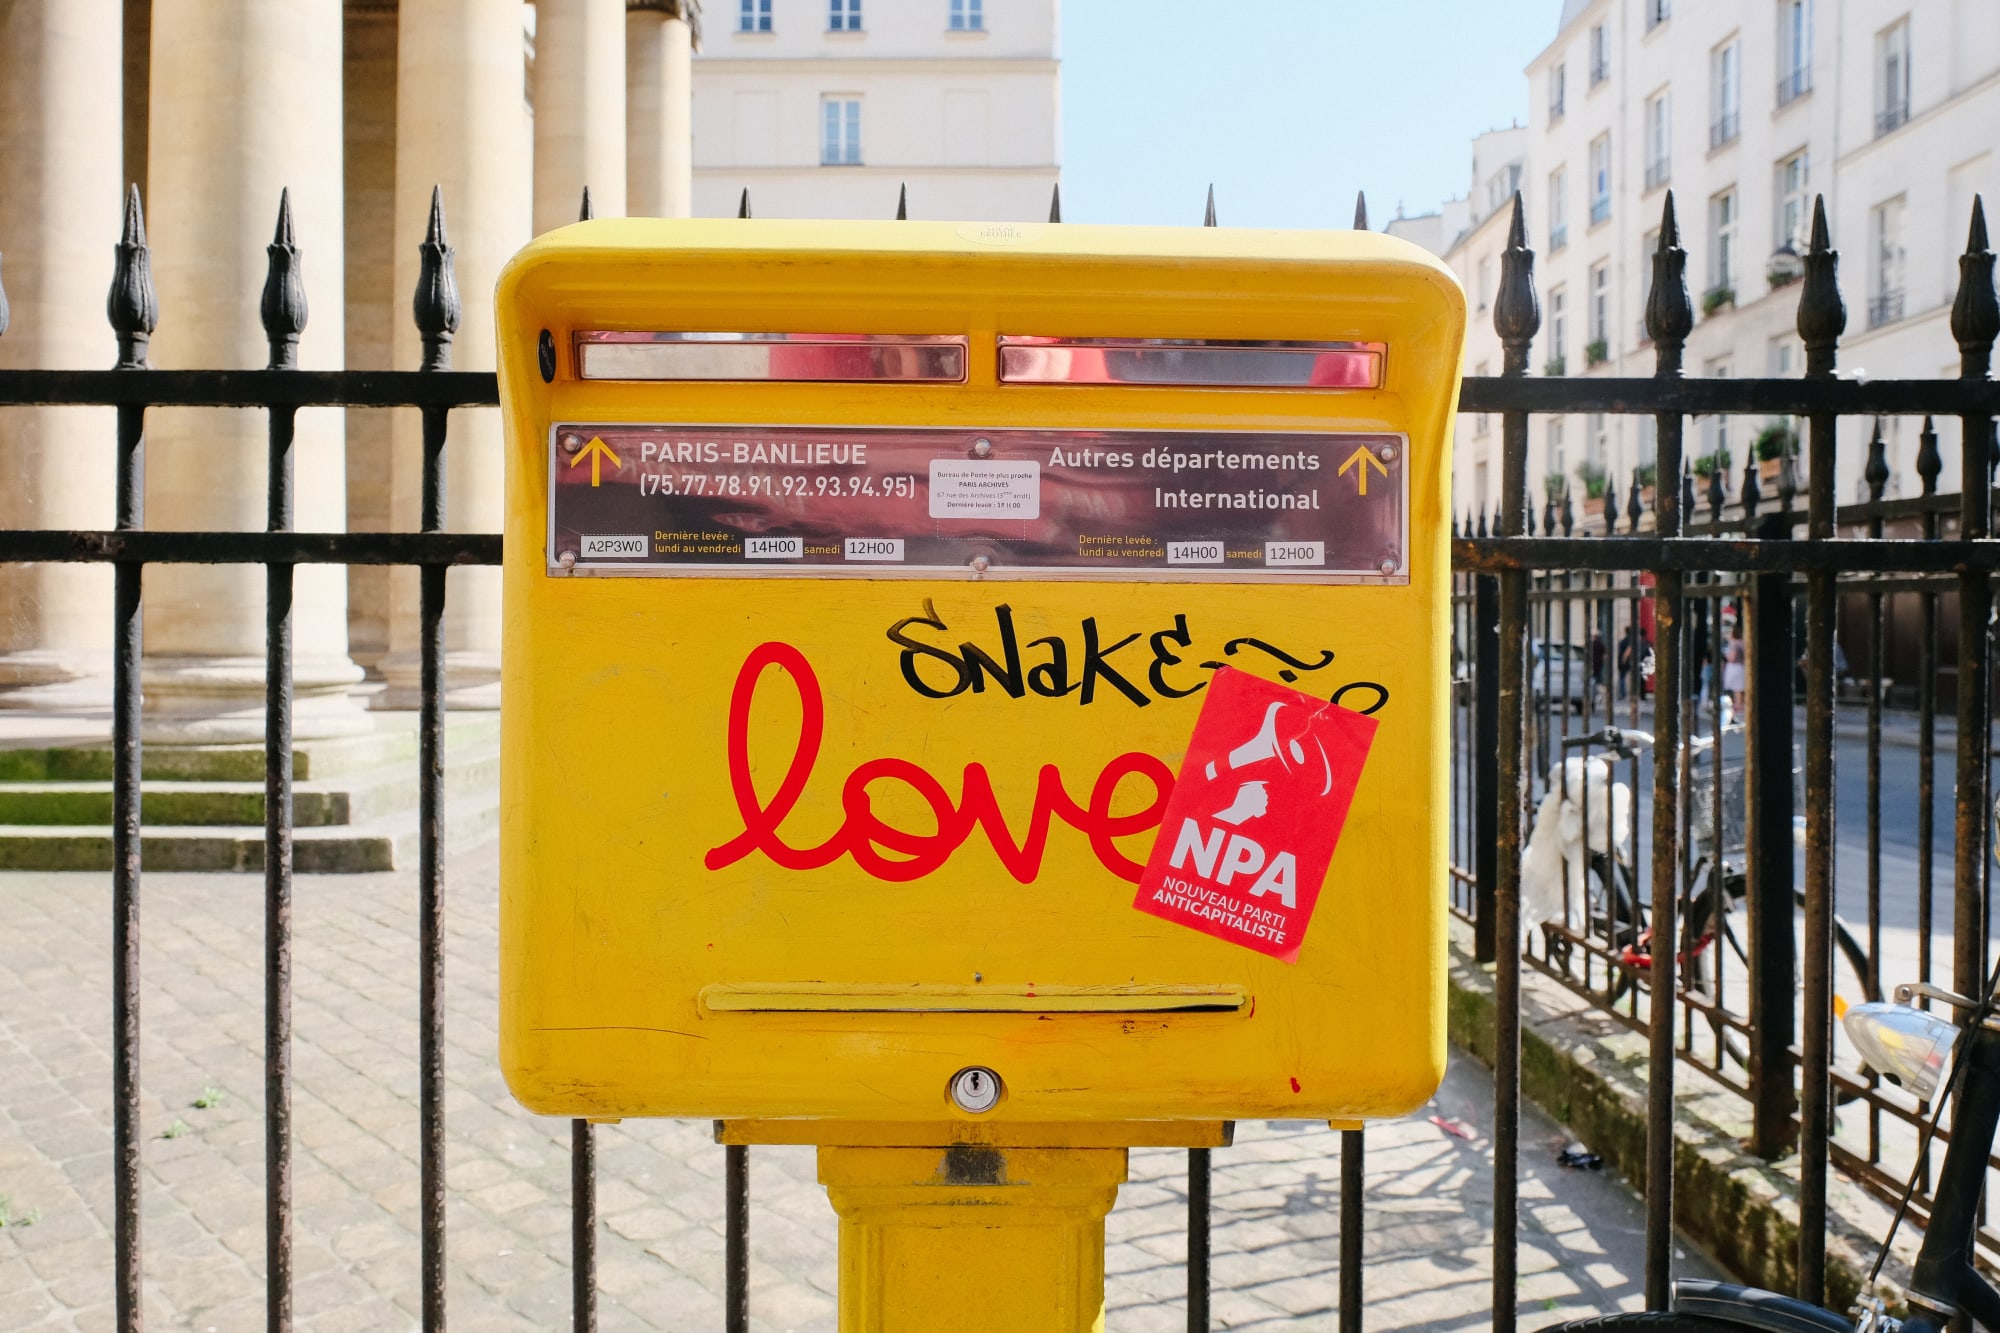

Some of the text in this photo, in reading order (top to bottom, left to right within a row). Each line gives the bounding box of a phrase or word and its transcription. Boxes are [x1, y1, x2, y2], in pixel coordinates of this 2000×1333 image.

[641, 442, 867, 465] PARIS-BANLIEUE
[1048, 446, 1320, 473] Autres départements
[996, 472, 1010, 480] plus
[640, 473, 915, 499] (75.77.78.91.92.93.94.95)
[1155, 488, 1320, 509] International
[947, 501, 974, 509] Dernière
[655, 531, 699, 541] Dernière
[701, 532, 729, 541] levée
[1079, 535, 1123, 544] Dernière
[1125, 535, 1152, 544] levée
[655, 543, 741, 553] lundi au vendredi
[751, 541, 796, 553] 14H00
[804, 545, 841, 554] samedi
[849, 542, 895, 554] 12H00
[1079, 548, 1164, 558] lundi au vendredi
[1173, 546, 1218, 559] 14H00
[1226, 551, 1262, 559] samedi
[1270, 547, 1315, 560] 12H00
[705, 641, 1176, 884] love
[1168, 817, 1297, 910] NPA
[1163, 875, 1286, 929] NOUVEAU PARTI
[1152, 888, 1286, 945] ANTICAPITALISTE
